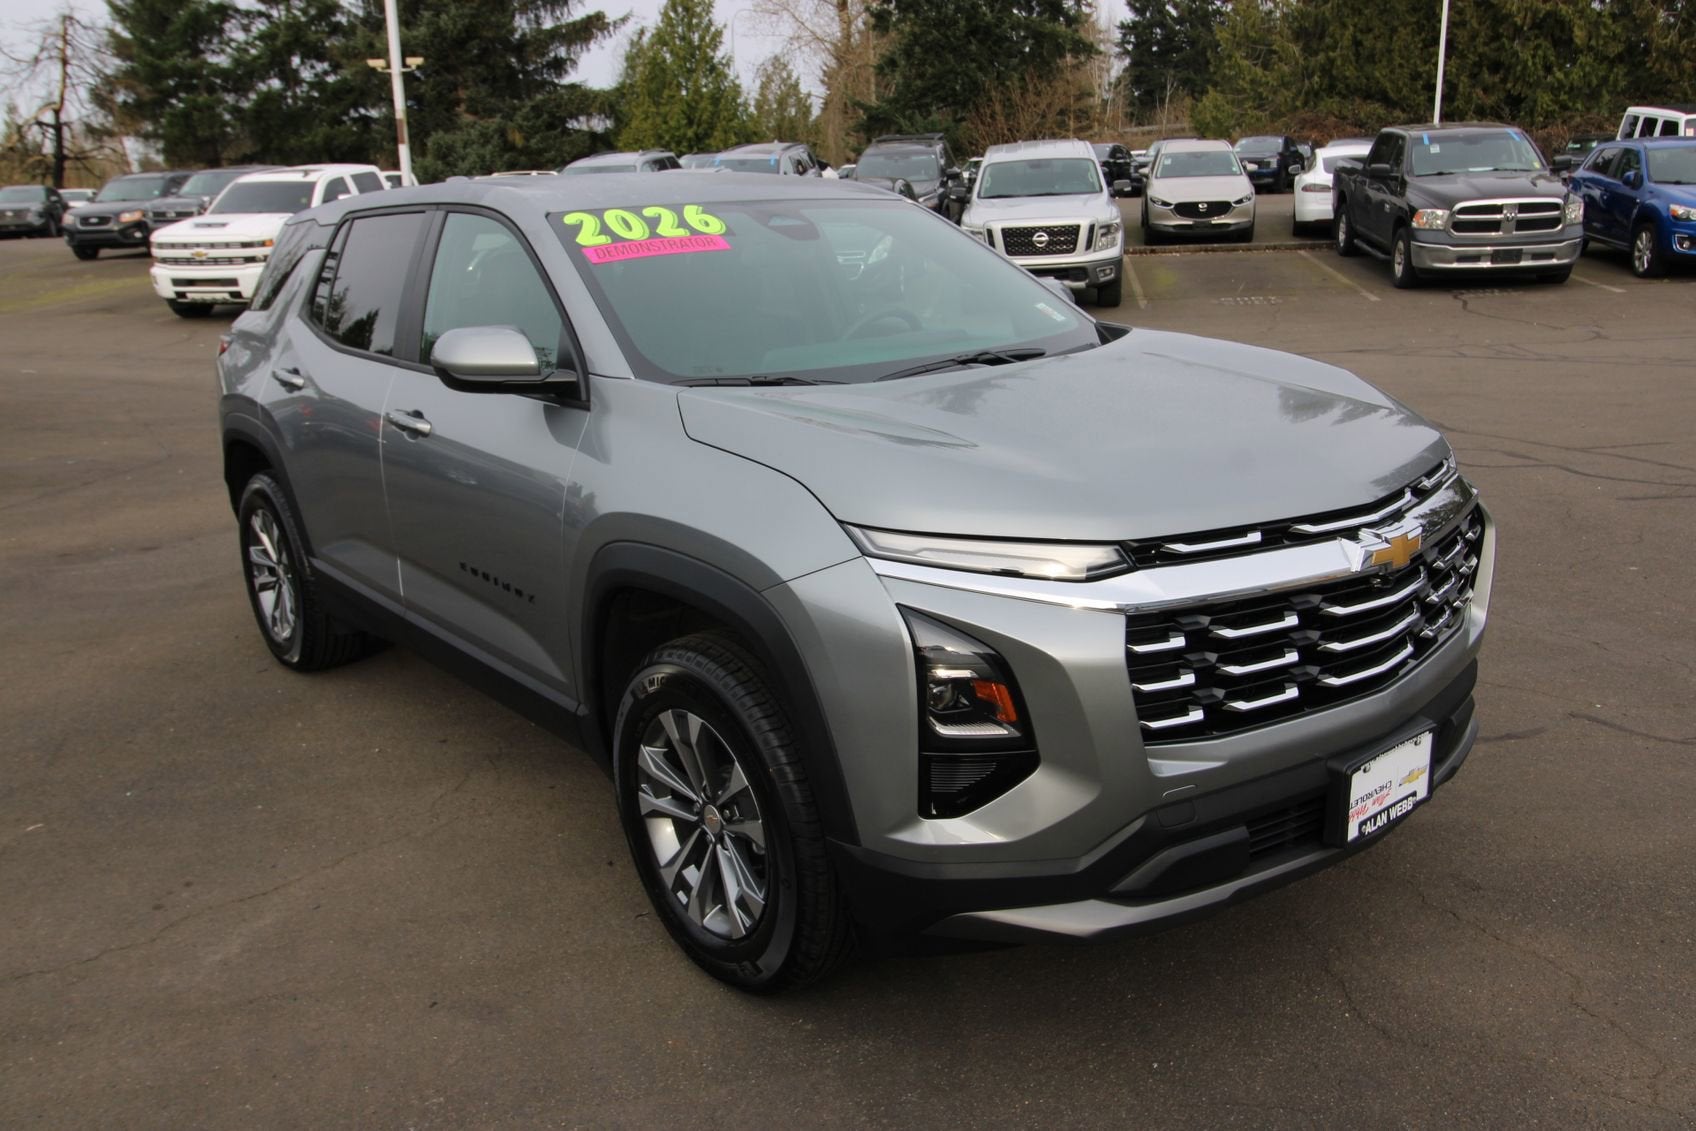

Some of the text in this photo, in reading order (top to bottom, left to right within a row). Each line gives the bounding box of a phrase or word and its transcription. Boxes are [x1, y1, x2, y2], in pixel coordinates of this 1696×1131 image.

[563, 205, 727, 246] 2026
[594, 237, 717, 260] DEMONSTRATOR
[1350, 780, 1392, 809] CHEVROLET
[1365, 796, 1413, 835] ALAN WEBB
